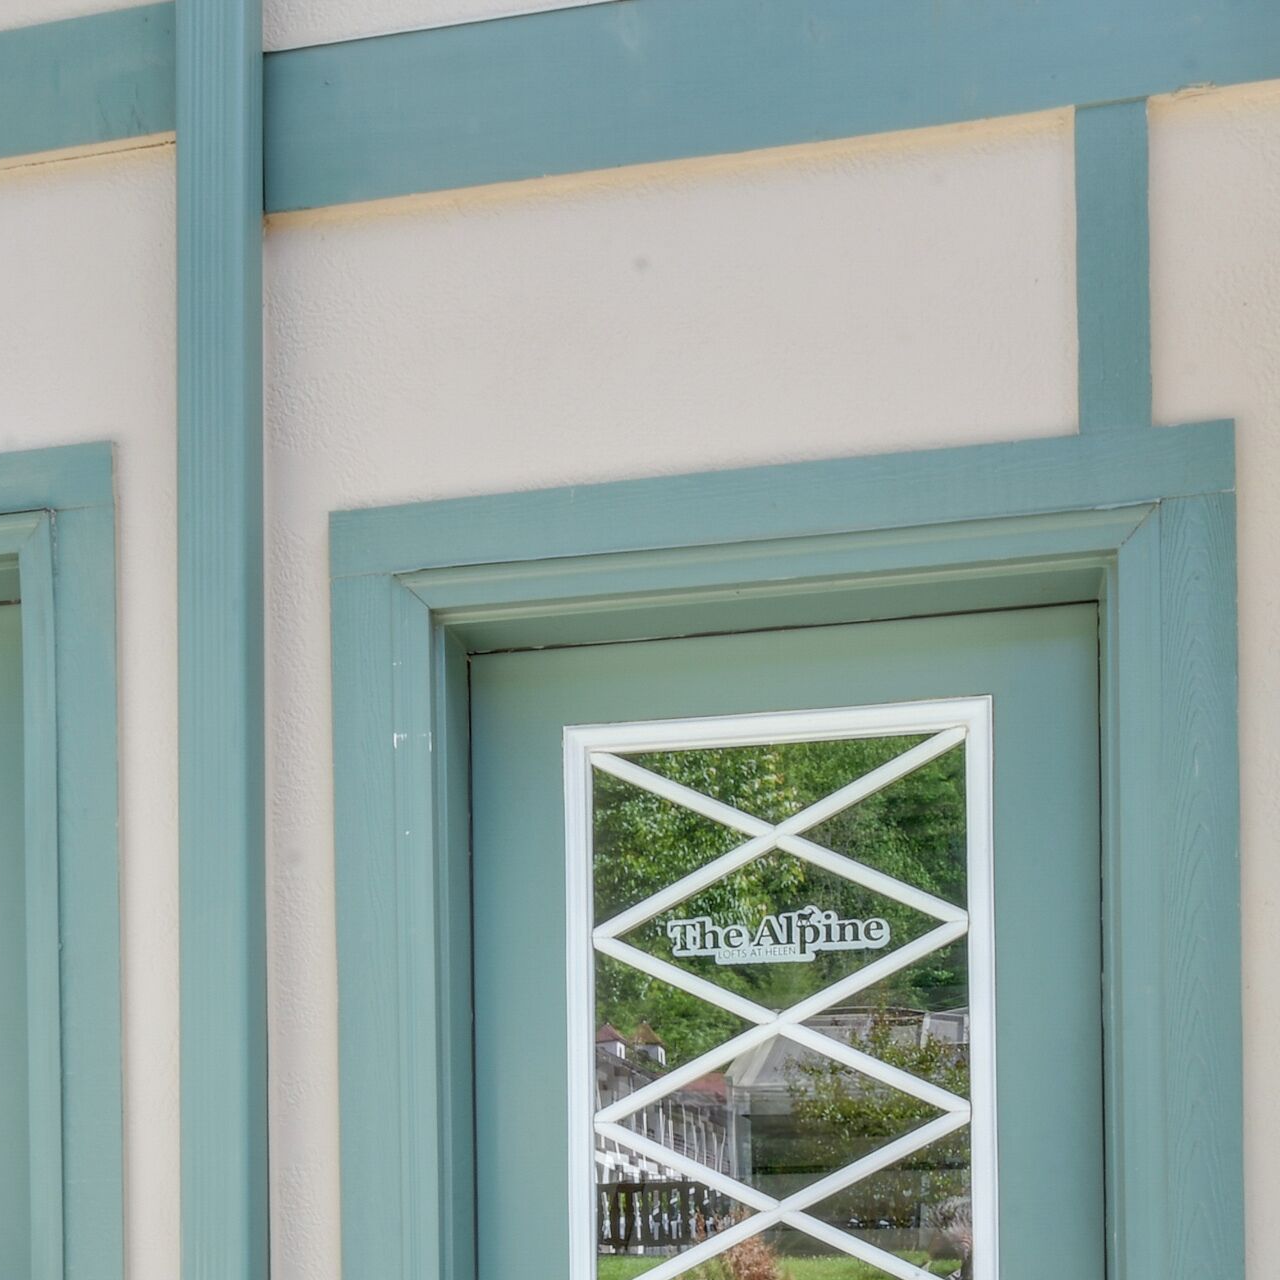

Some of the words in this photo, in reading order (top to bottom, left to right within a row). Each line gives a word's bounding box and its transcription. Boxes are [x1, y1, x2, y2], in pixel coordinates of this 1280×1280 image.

[670, 920, 744, 951] The
[753, 912, 884, 955] Alpine
[718, 949, 747, 959] LOFTS
[750, 948, 762, 957] AT
[766, 946, 796, 956] HELEN
